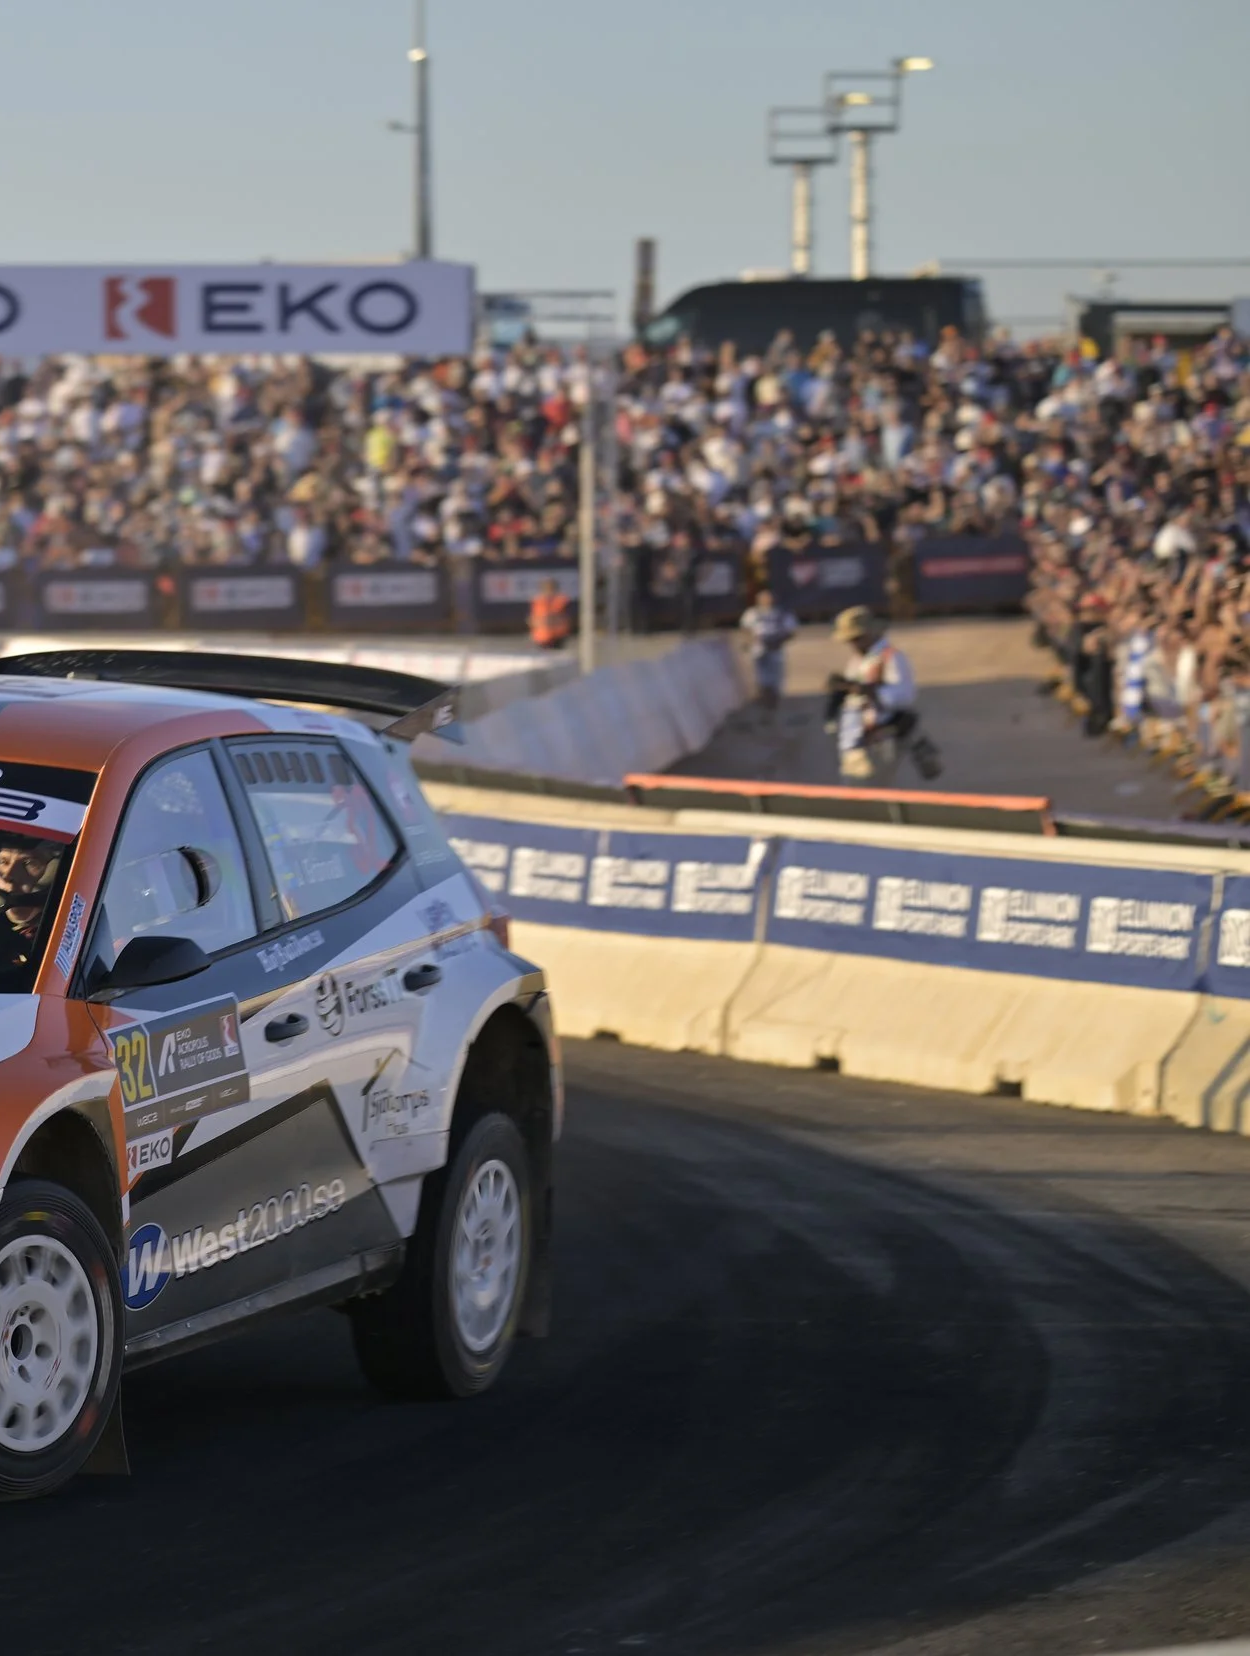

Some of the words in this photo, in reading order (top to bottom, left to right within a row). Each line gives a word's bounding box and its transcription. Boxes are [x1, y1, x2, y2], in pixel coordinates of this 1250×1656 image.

[200, 281, 419, 335] EKO
[175, 1027, 191, 1041] EKO
[177, 1035, 210, 1056] ACROPOLIS
[116, 1030, 152, 1103] 32
[179, 1053, 198, 1071] RALLY
[139, 1136, 171, 1165] EKO
